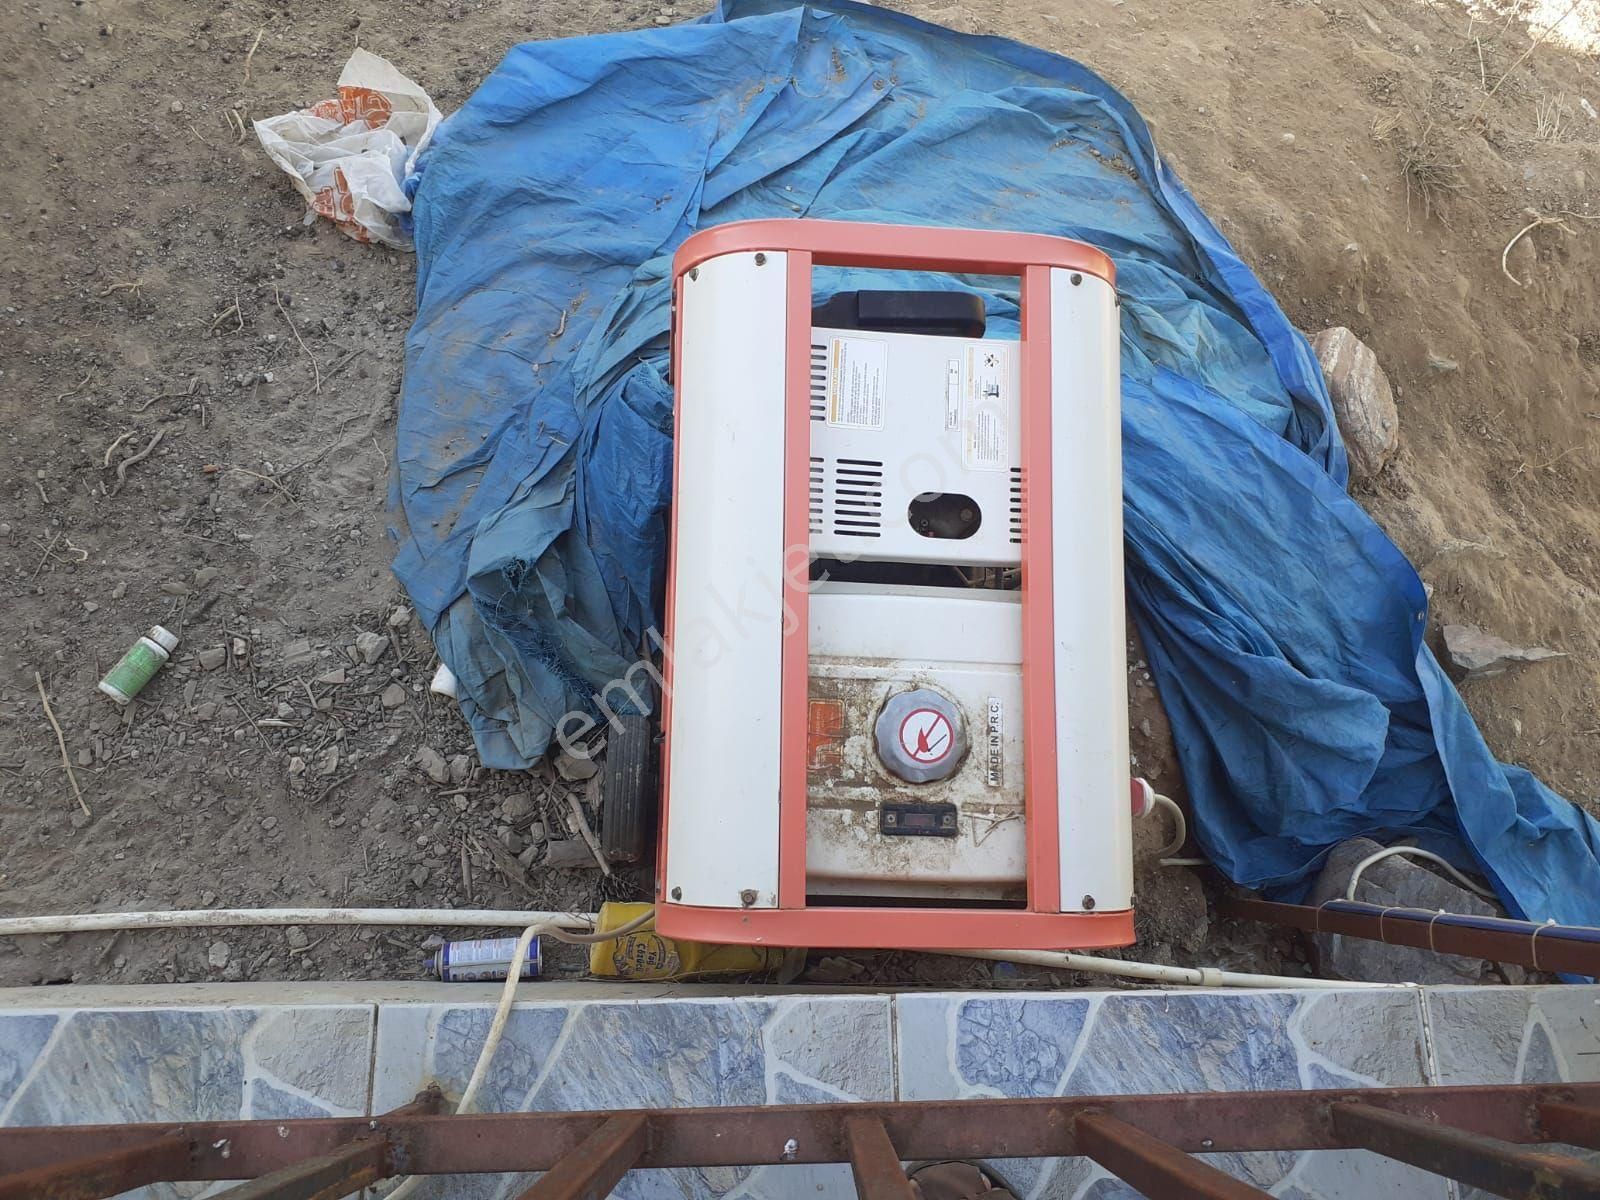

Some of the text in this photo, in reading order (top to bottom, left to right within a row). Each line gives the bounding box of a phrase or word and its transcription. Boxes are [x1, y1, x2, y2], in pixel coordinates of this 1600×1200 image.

[990, 702, 1000, 782] MADE IN P.R.C.
